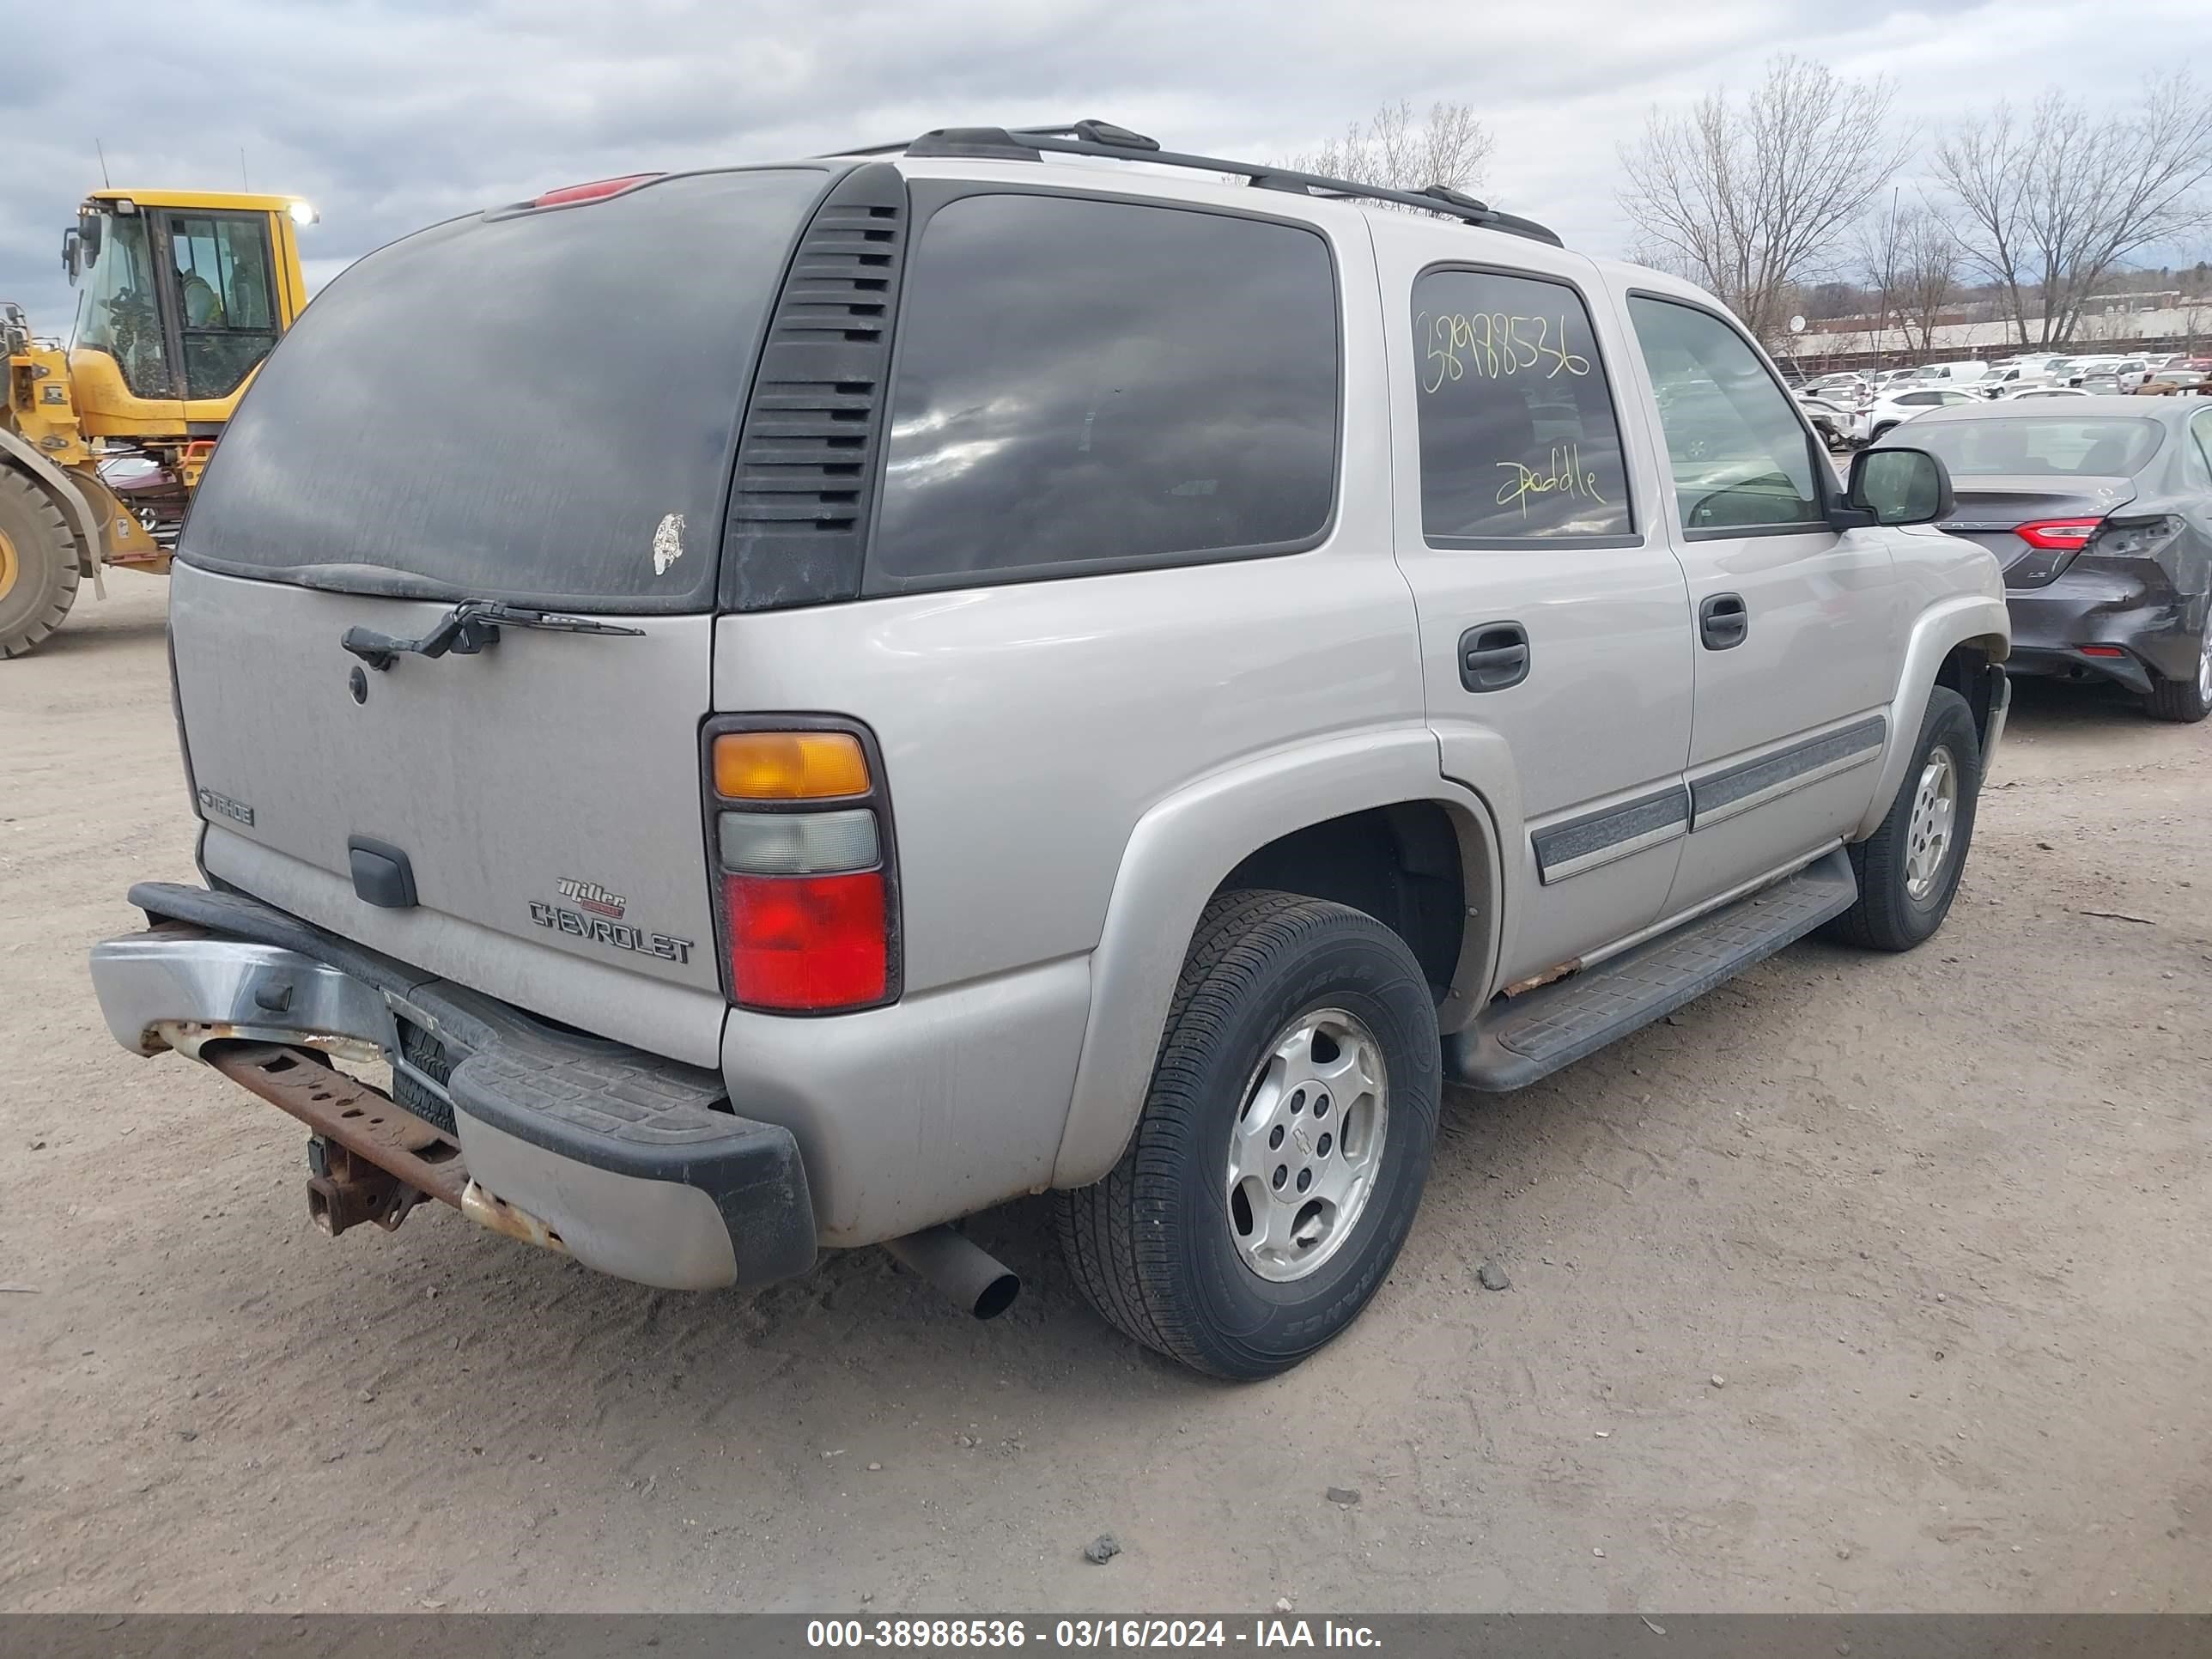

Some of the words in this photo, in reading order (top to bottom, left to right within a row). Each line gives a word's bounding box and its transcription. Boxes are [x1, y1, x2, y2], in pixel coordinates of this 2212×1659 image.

[1417, 310, 1590, 394] 38988536
[556, 877, 627, 908] Miller
[528, 901, 695, 964] CHEVROLET
